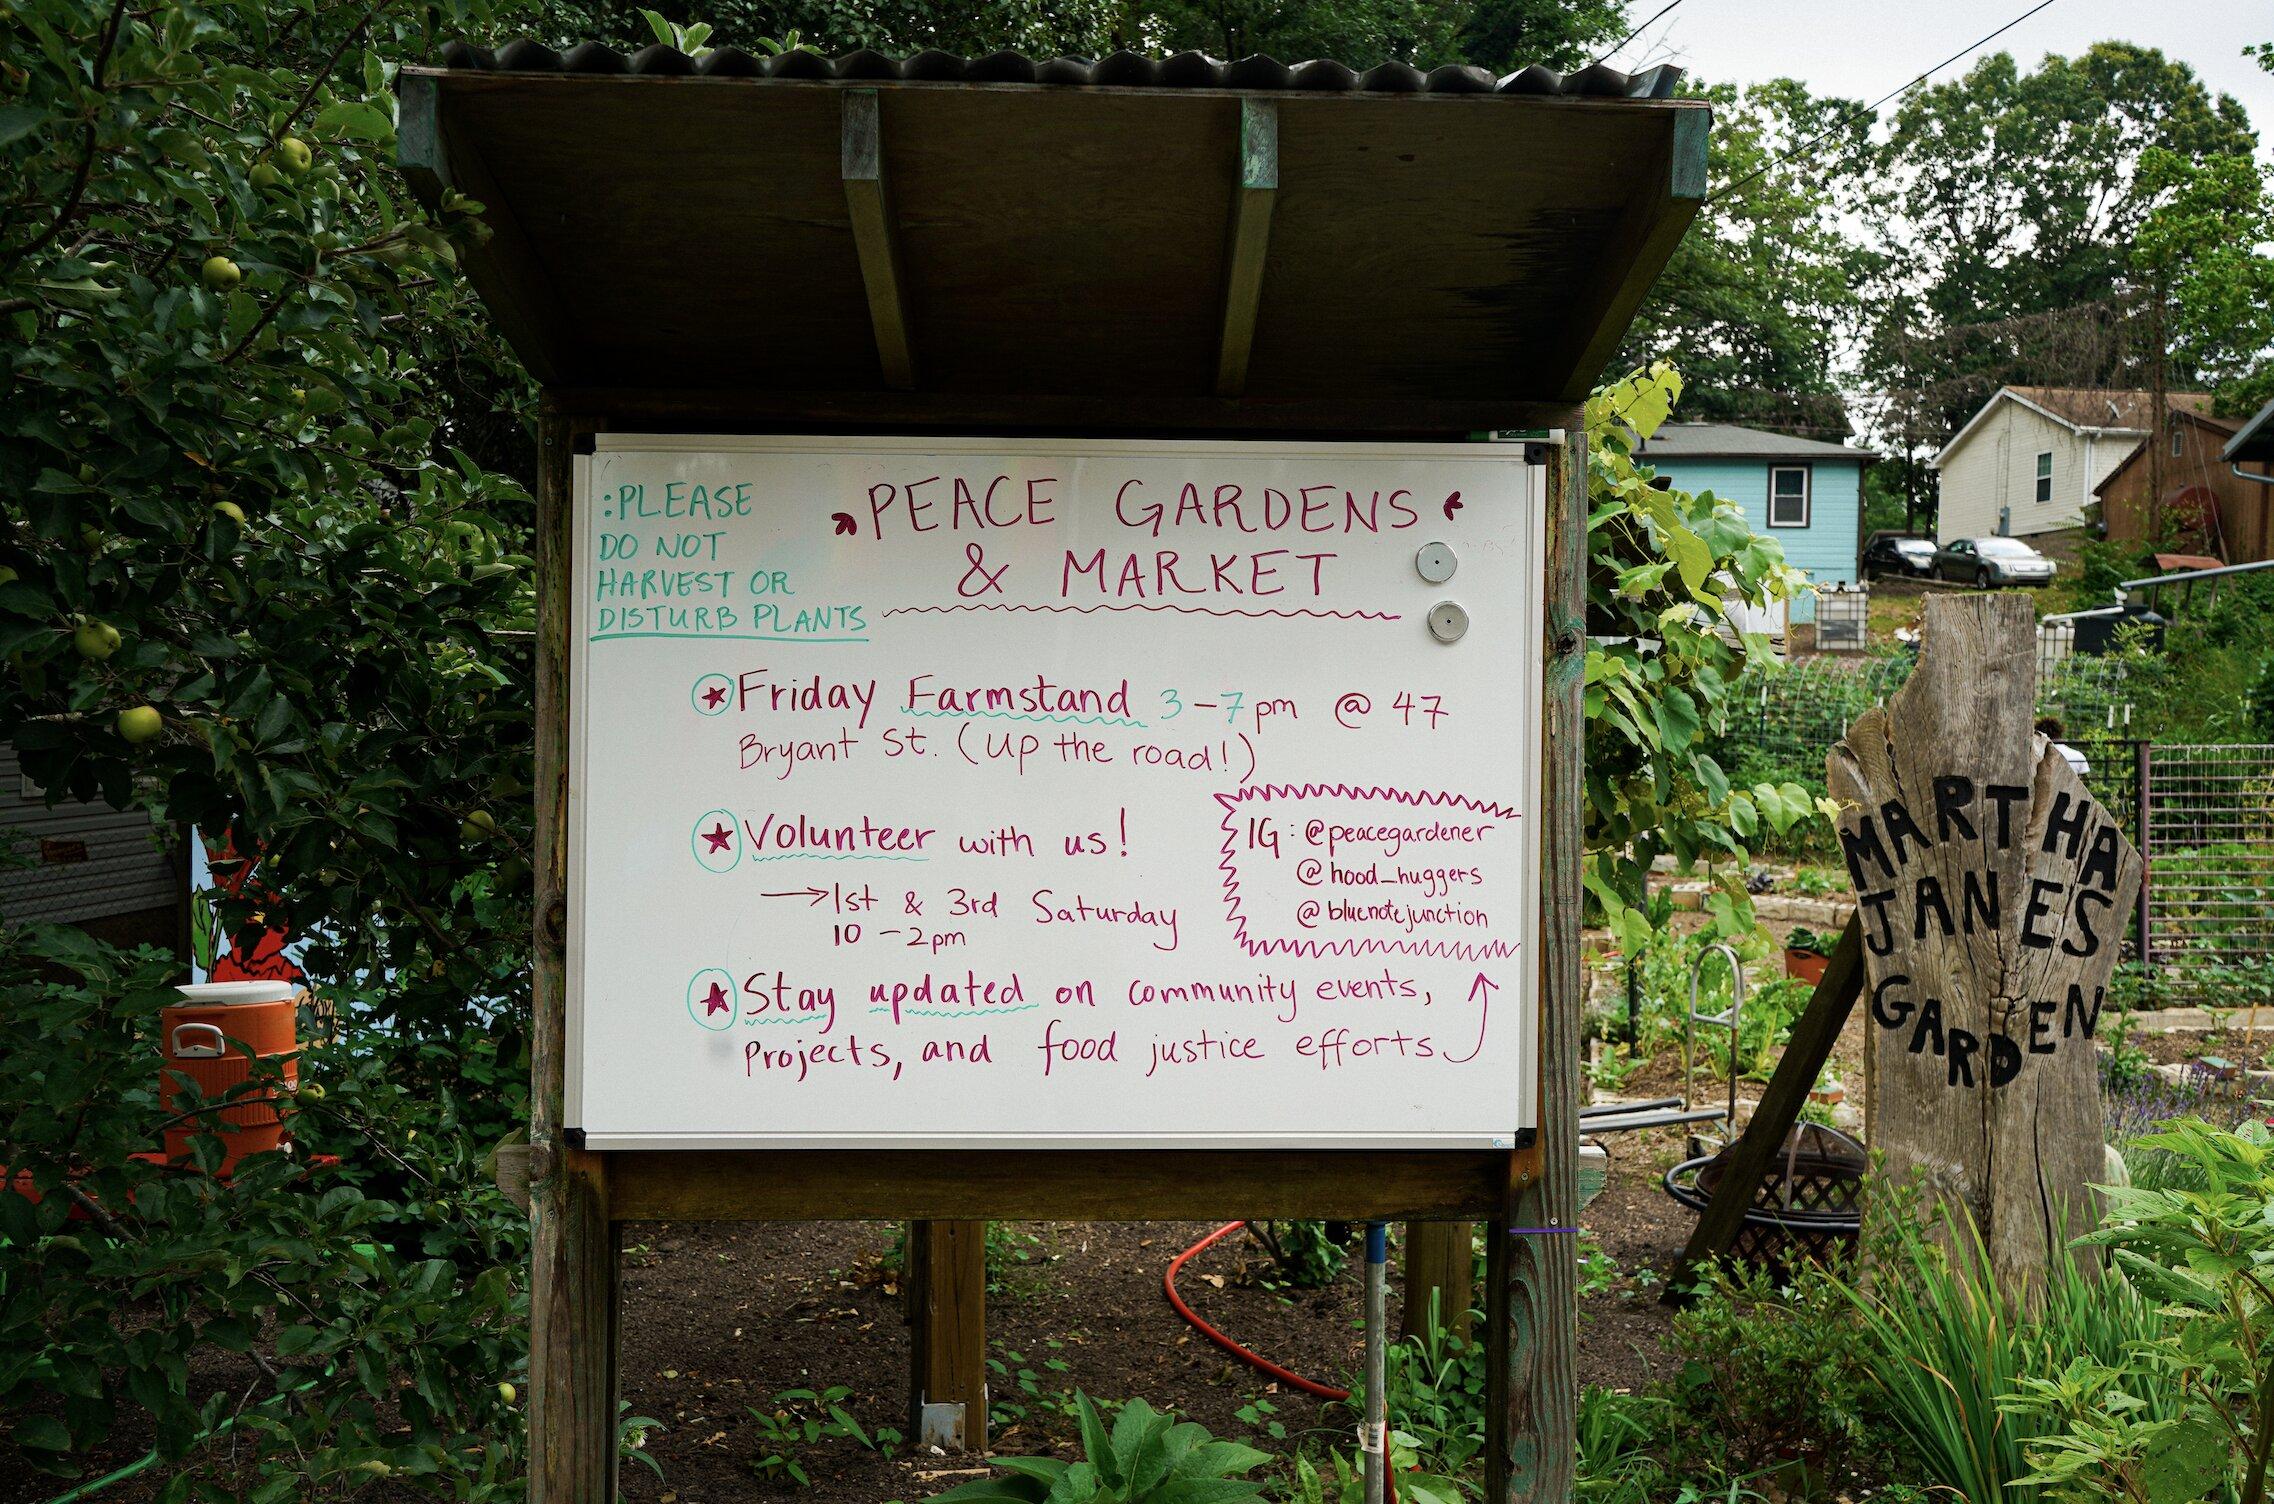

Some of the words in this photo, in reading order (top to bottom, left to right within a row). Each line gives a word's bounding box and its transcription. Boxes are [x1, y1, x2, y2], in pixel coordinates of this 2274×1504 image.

[869, 476, 1058, 540] PEACE
[1116, 479, 1419, 537] GARDENS
[600, 533, 637, 560] DO
[657, 532, 727, 560] NOT
[958, 542, 1009, 597] &
[1062, 549, 1337, 597] MARKET
[597, 570, 733, 600] HARVEST
[750, 571, 795, 595] OR
[599, 606, 738, 632] DISTURB
[754, 605, 866, 632] PLANTS
[739, 669, 876, 728] Friday
[908, 674, 1131, 717] Farmstand
[1335, 692, 1371, 728] @
[1392, 690, 1449, 729] 47
[739, 726, 859, 779] Bryant
[885, 727, 937, 757] St.
[1054, 732, 1114, 763] the
[1133, 733, 1255, 780] road!)
[744, 814, 936, 851] Volunteer
[959, 825, 1035, 858] with
[1064, 807, 1127, 857] us!
[1305, 819, 1495, 857] @peacegardener
[1841, 775, 2119, 892] MARTHA
[835, 883, 879, 914] 1st
[905, 891, 922, 915] &
[947, 888, 998, 918] 3rd
[1032, 890, 1177, 951] Saturday
[1860, 870, 2113, 957] JANES
[744, 973, 835, 1034] Stay
[870, 971, 1024, 1025] updated
[1055, 979, 1095, 1007] on
[1129, 974, 1297, 1022] community
[1317, 969, 1431, 1006] events,
[922, 1034, 992, 1064] and
[1038, 1020, 1118, 1076] food
[1146, 1029, 1264, 1077] justice
[1296, 1028, 1433, 1069] efforts
[1872, 975, 2105, 1088] GARDEN
